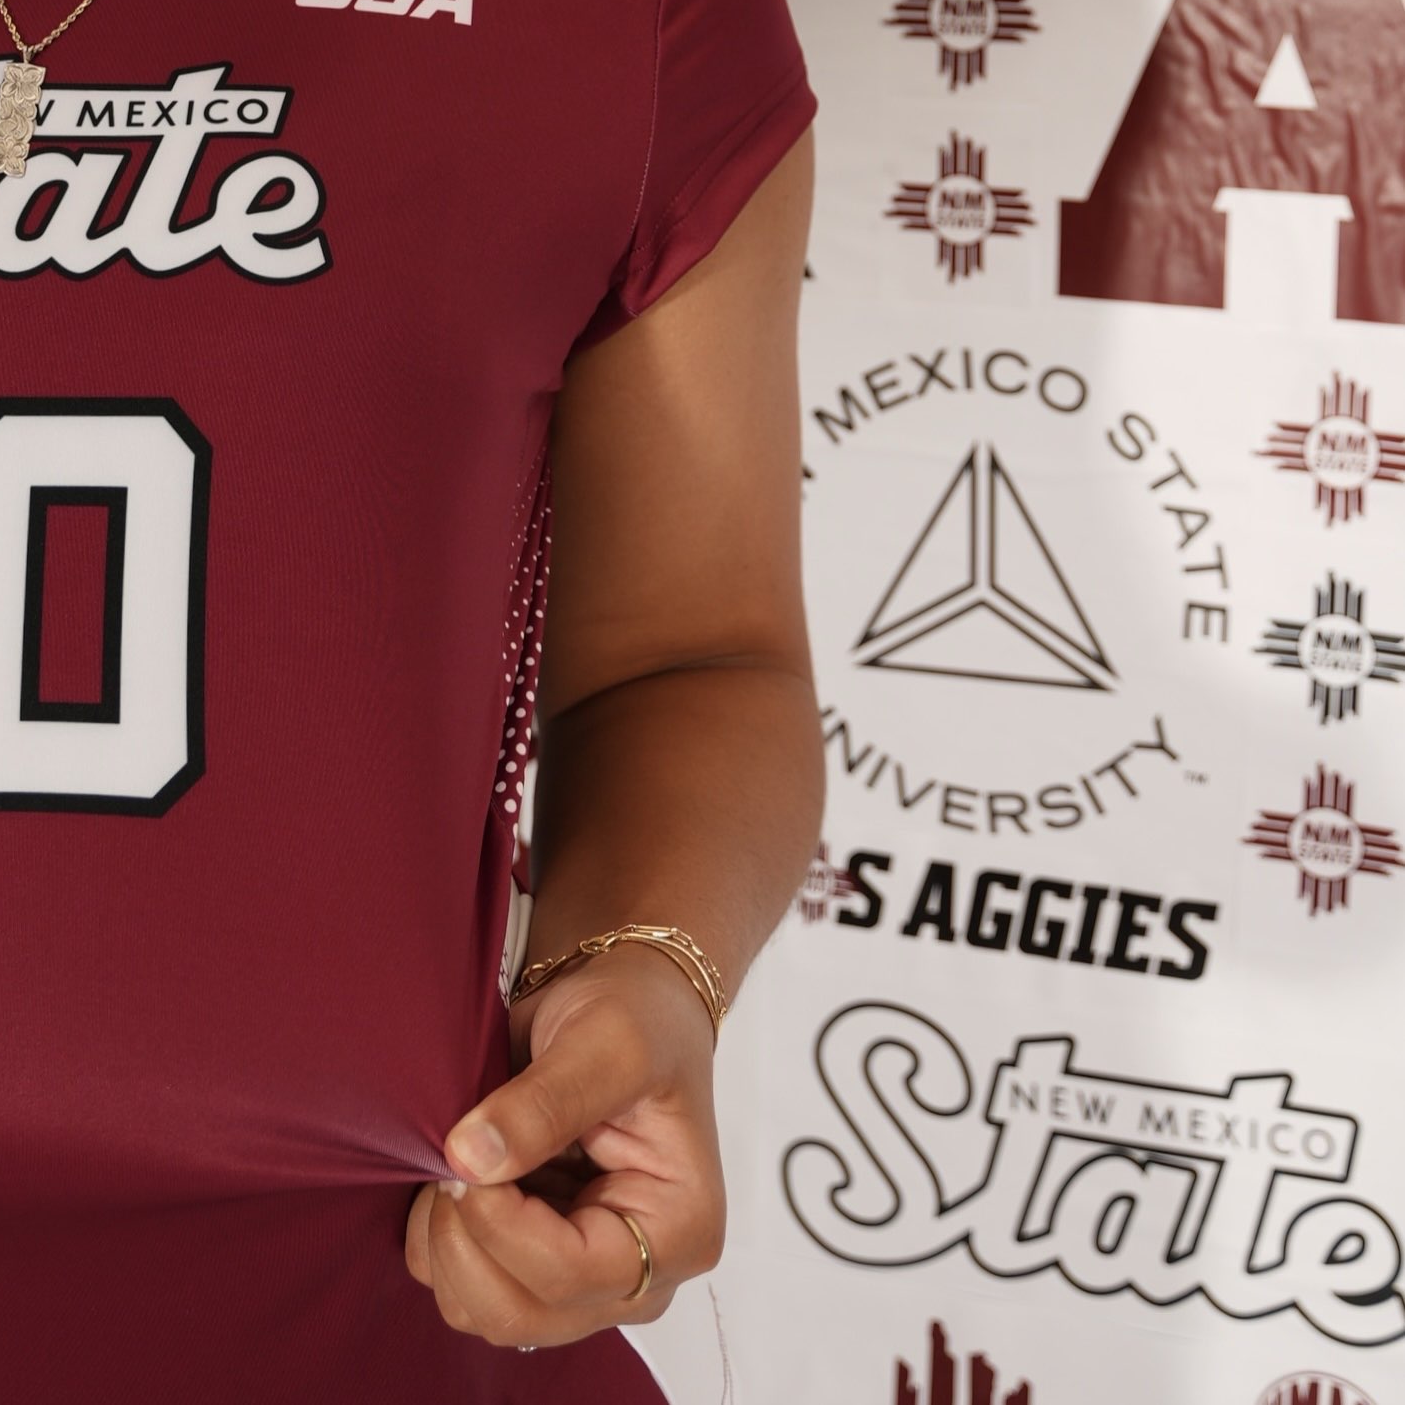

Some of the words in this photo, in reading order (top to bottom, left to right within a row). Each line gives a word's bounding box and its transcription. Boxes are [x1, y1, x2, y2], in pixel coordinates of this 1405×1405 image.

[75, 98, 270, 127] MEXICO
[812, 347, 1090, 445] MEXICO
[1106, 411, 1230, 644] STATE
[820, 708, 1180, 836] NIVERSITY
[899, 860, 1220, 981] AGGIES
[782, 998, 1405, 1349] State
[1009, 1080, 1118, 1125] NEW
[1137, 1103, 1337, 1164] MEXICO
